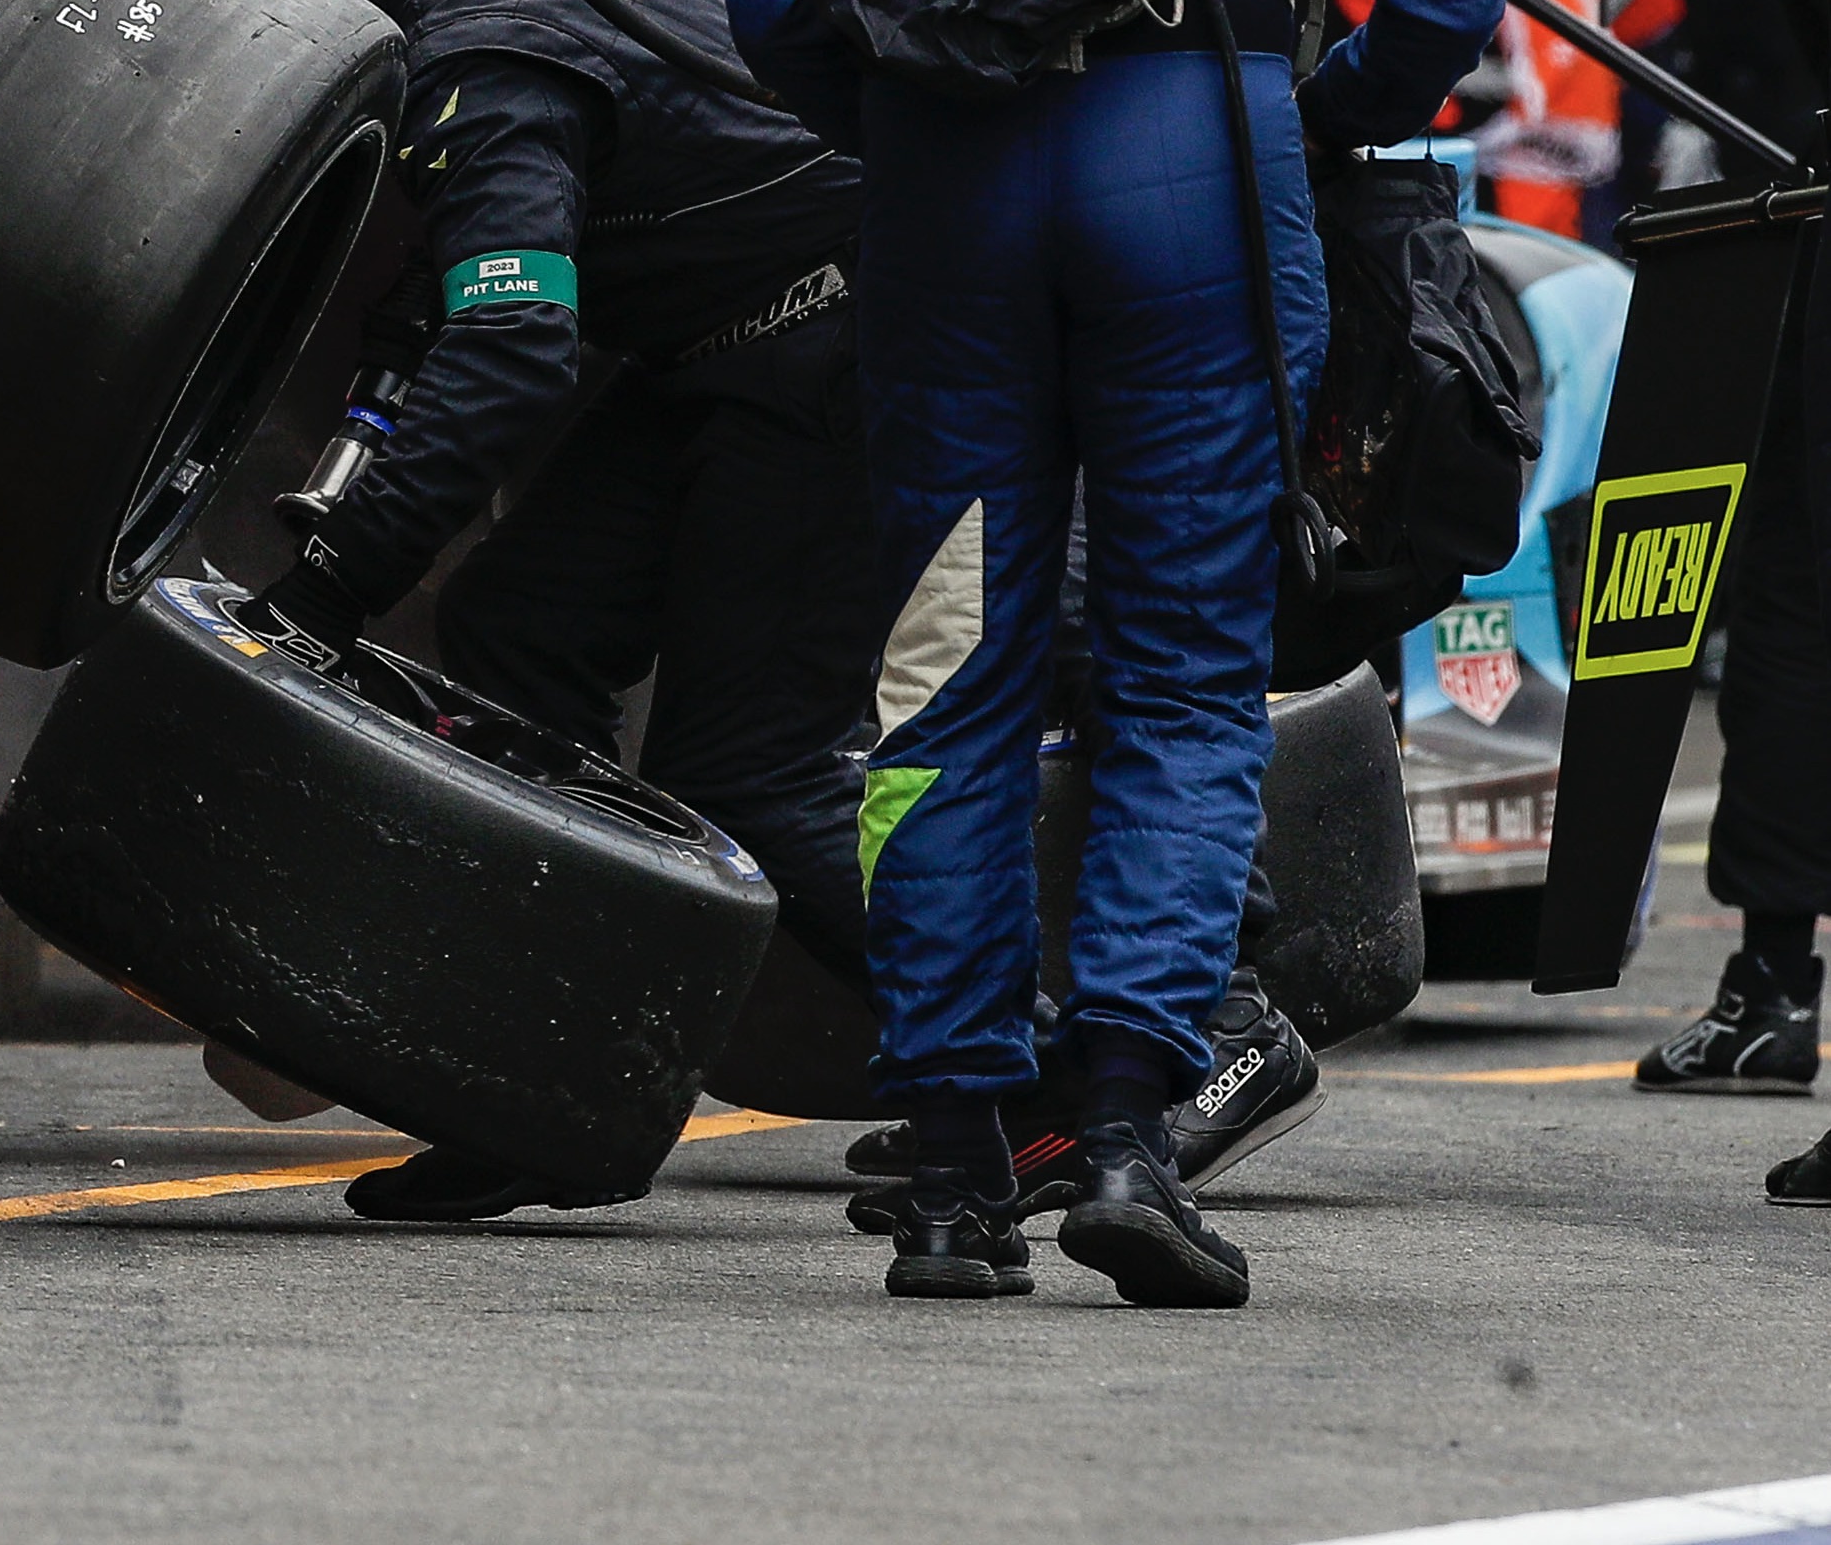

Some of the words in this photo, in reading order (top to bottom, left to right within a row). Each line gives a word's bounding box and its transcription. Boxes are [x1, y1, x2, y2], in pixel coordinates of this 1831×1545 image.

[487, 262, 515, 273] 2023
[463, 282, 490, 298] PIT
[494, 279, 540, 293] LANE
[1593, 520, 1712, 626] READY
[1440, 612, 1507, 650] TAG
[1195, 1046, 1266, 1119] sparco
